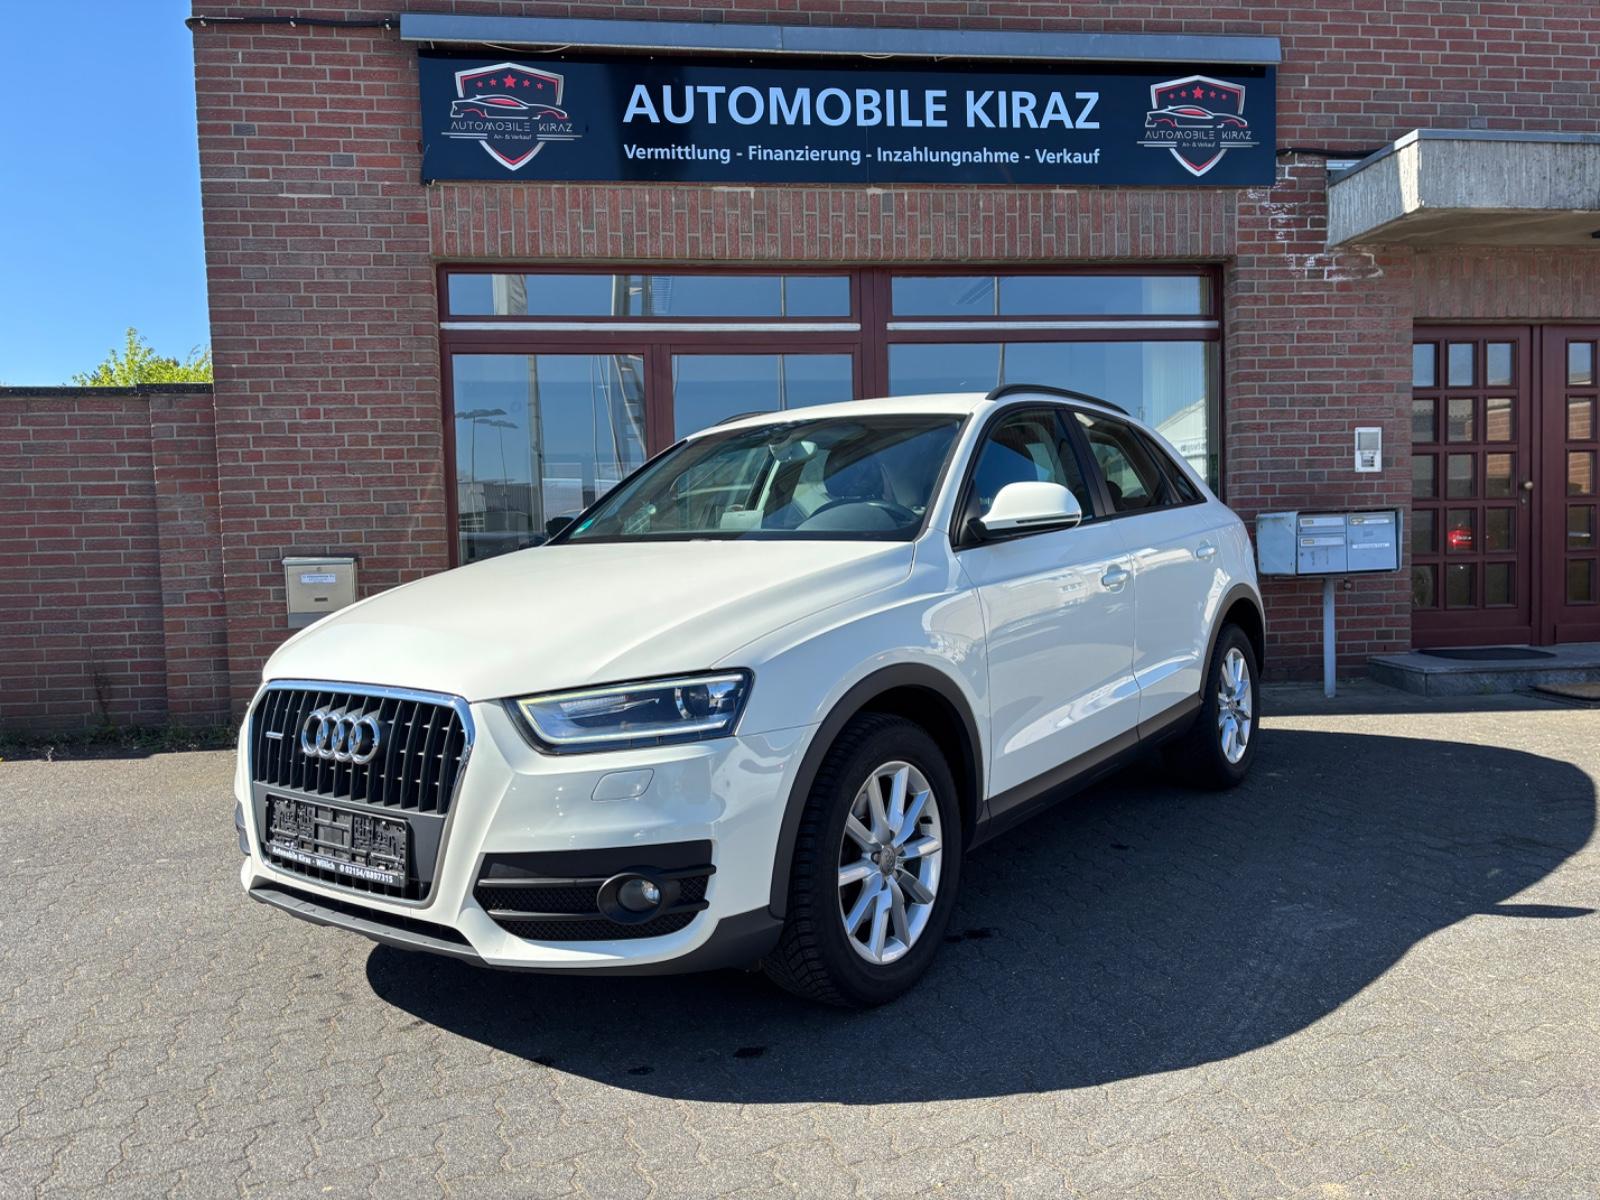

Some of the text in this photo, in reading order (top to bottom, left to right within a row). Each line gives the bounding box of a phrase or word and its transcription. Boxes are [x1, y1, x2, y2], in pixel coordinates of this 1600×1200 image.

[622, 84, 1100, 129] AUTOMOBILE KIRAZ
[450, 121, 574, 133] AUTOMOBILE KIRAZ
[1144, 130, 1252, 140] AUTOMOBILE KIRAZ
[623, 143, 731, 165] Vermittlung
[748, 144, 861, 166] Finanzierung
[877, 146, 1020, 167] Inzahlungnahme
[1034, 148, 1101, 165] Verkauf
